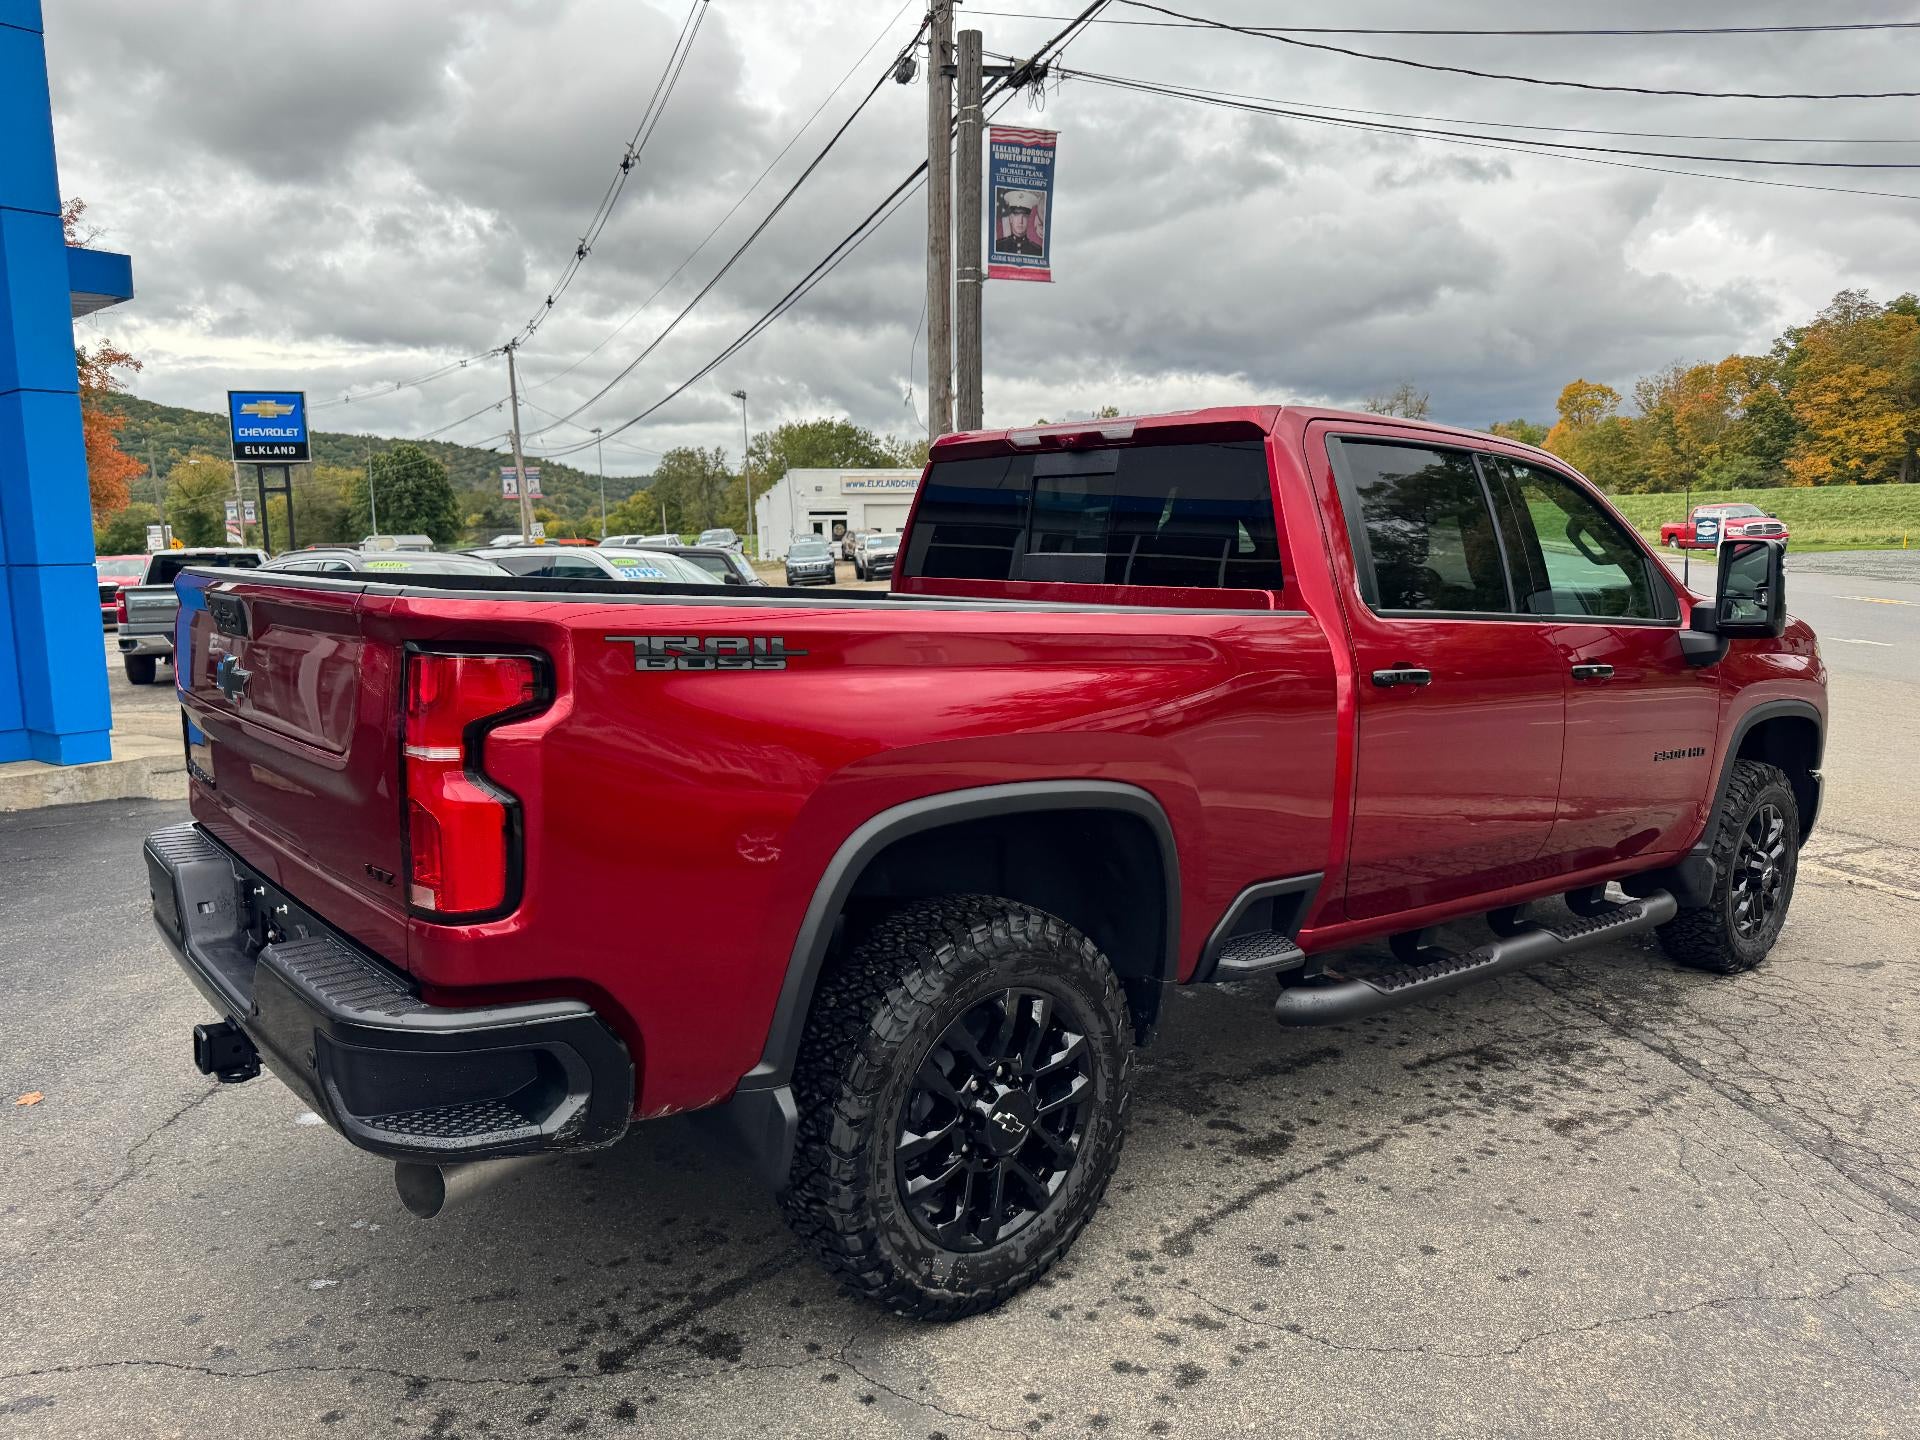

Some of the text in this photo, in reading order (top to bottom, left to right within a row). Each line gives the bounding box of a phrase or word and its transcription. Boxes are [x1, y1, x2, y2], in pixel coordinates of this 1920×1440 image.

[1000, 167, 1025, 176] MICHAEL
[1006, 176, 1029, 185] MARINE
[238, 427, 299, 437] CHEVROLET
[244, 445, 296, 455] ELKLAND
[604, 636, 809, 656] TRAIL
[635, 655, 787, 671] BOSS
[1687, 747, 1705, 757] HD
